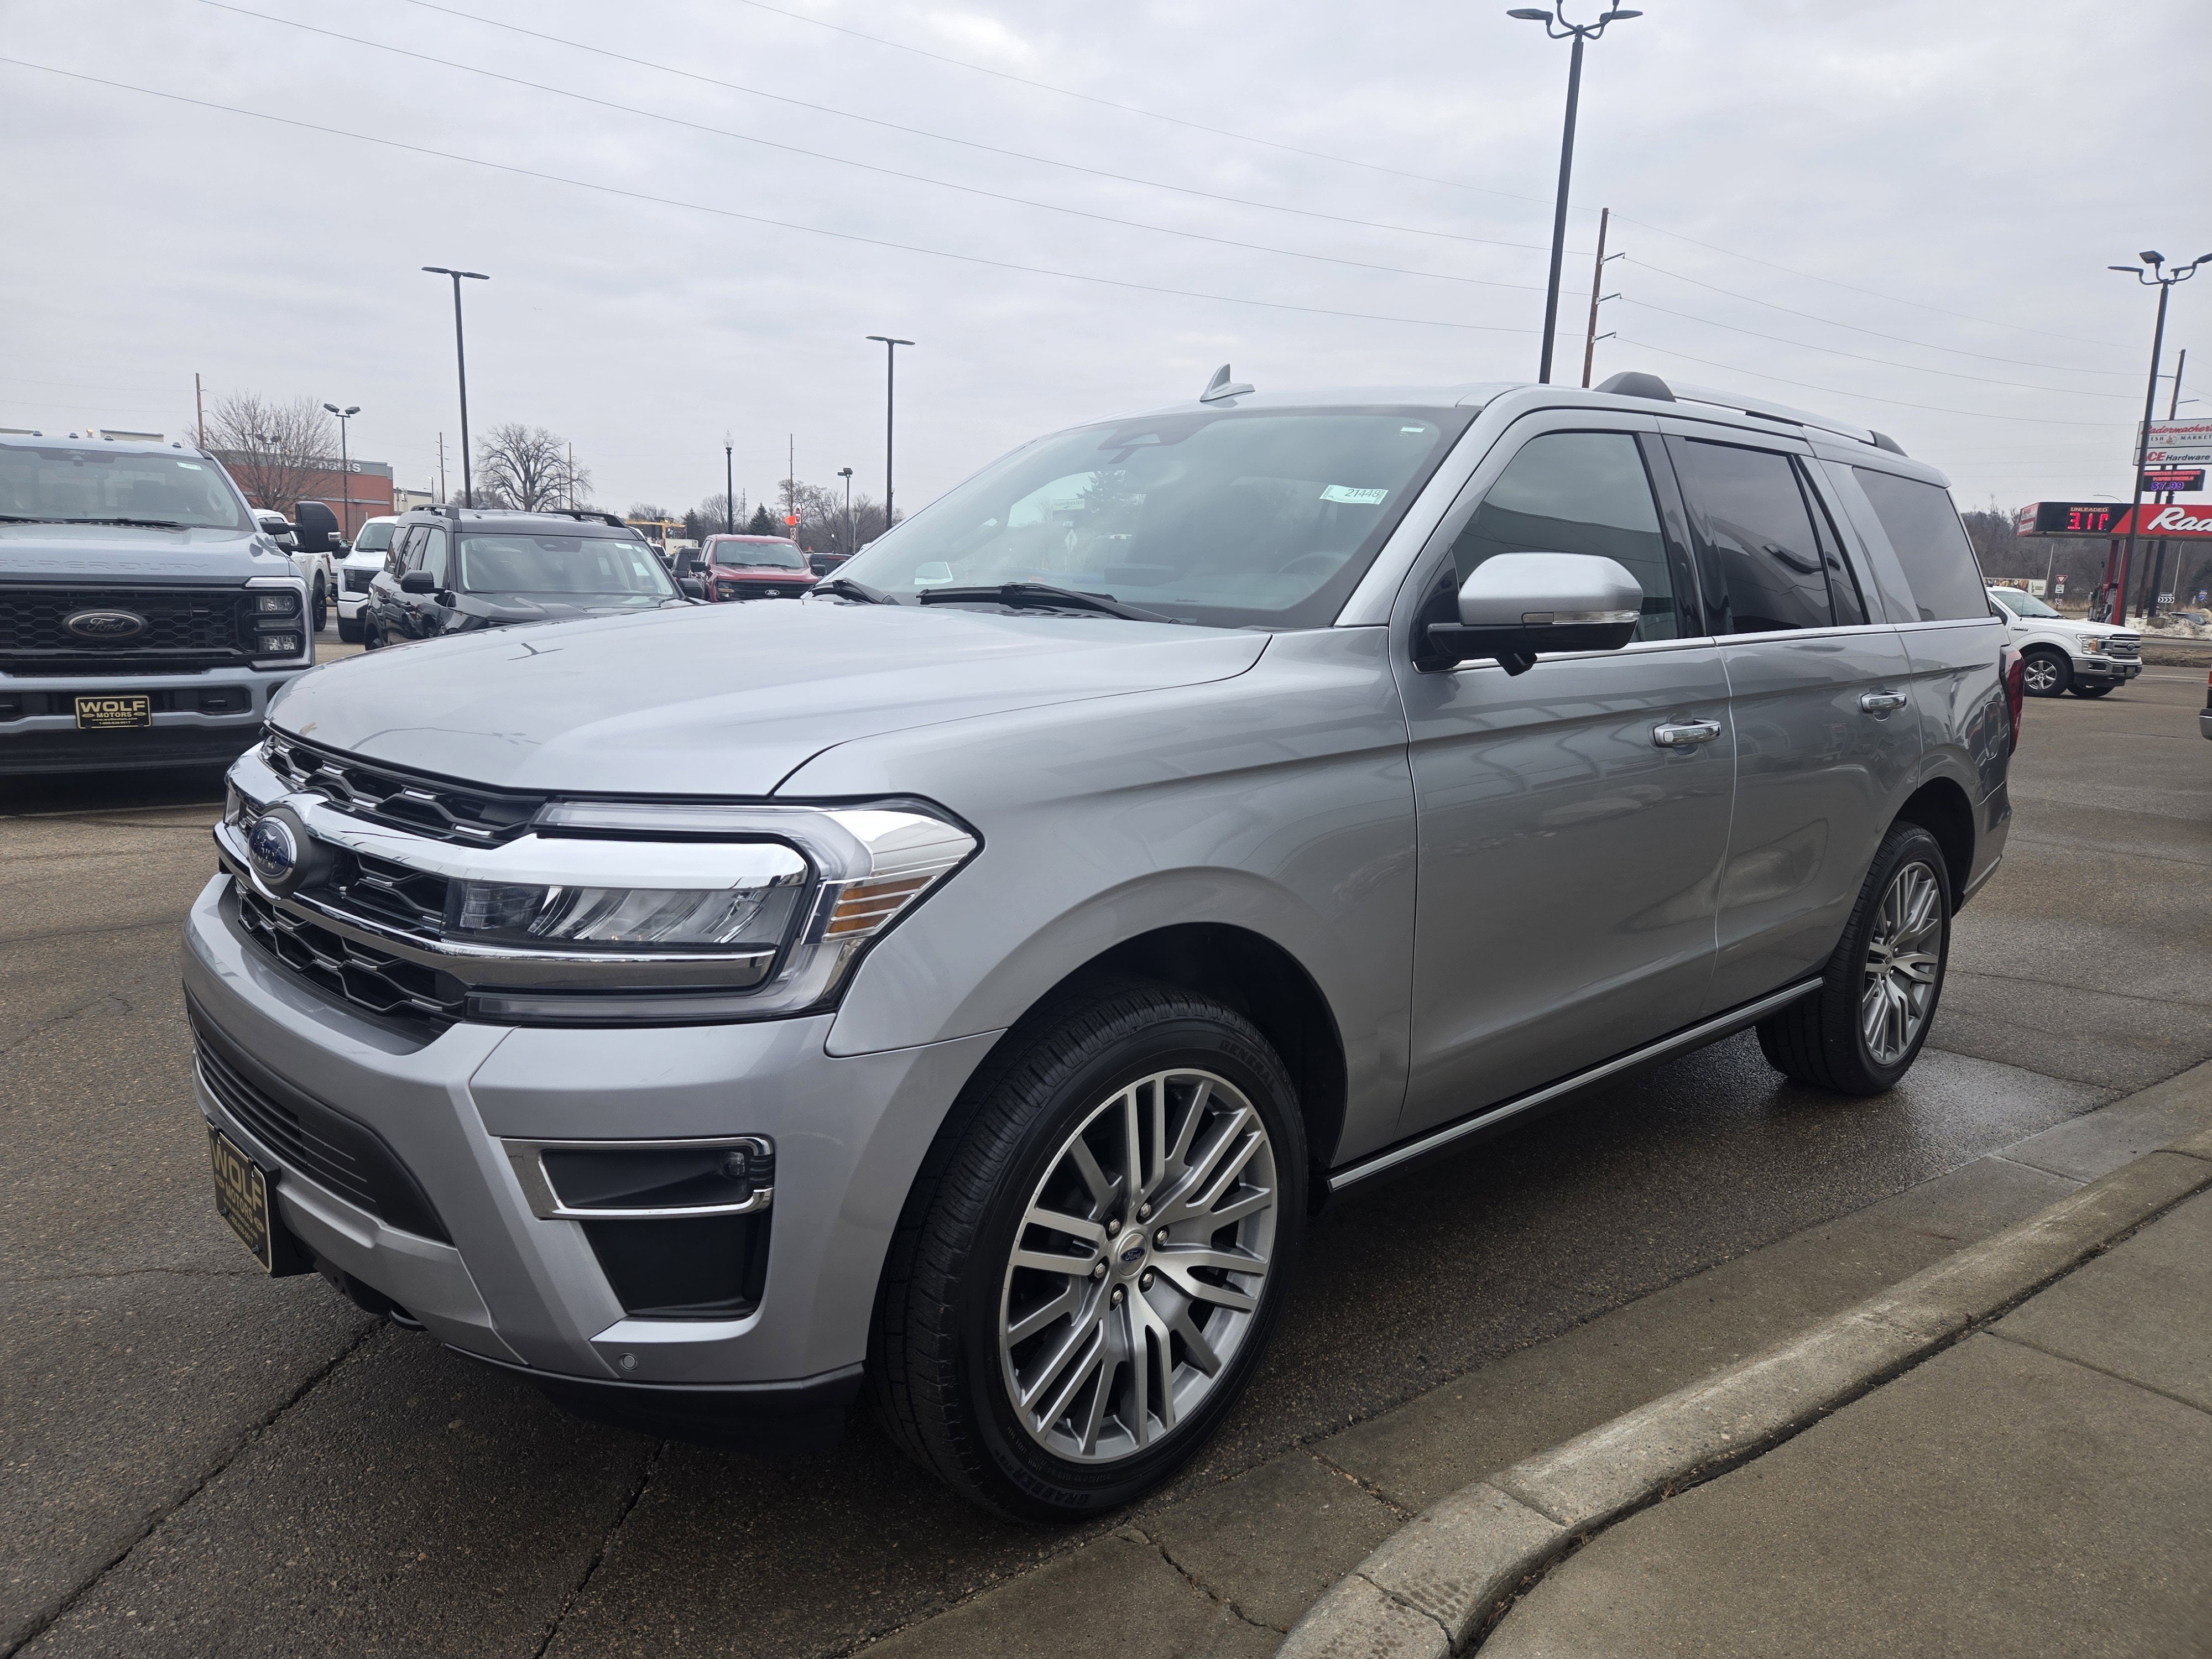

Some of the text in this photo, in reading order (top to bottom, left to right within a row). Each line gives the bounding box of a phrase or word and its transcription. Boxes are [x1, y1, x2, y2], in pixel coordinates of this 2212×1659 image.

[2141, 424, 2212, 434] adermacher'
[2151, 482, 2184, 491] $7.99
[1344, 488, 1381, 497] 21448
[86, 617, 125, 632] Ford
[80, 701, 145, 712] WOLF
[211, 1137, 263, 1211] WOLF
[225, 1181, 253, 1224] MOTORS
[1125, 1249, 1141, 1261] Ford
